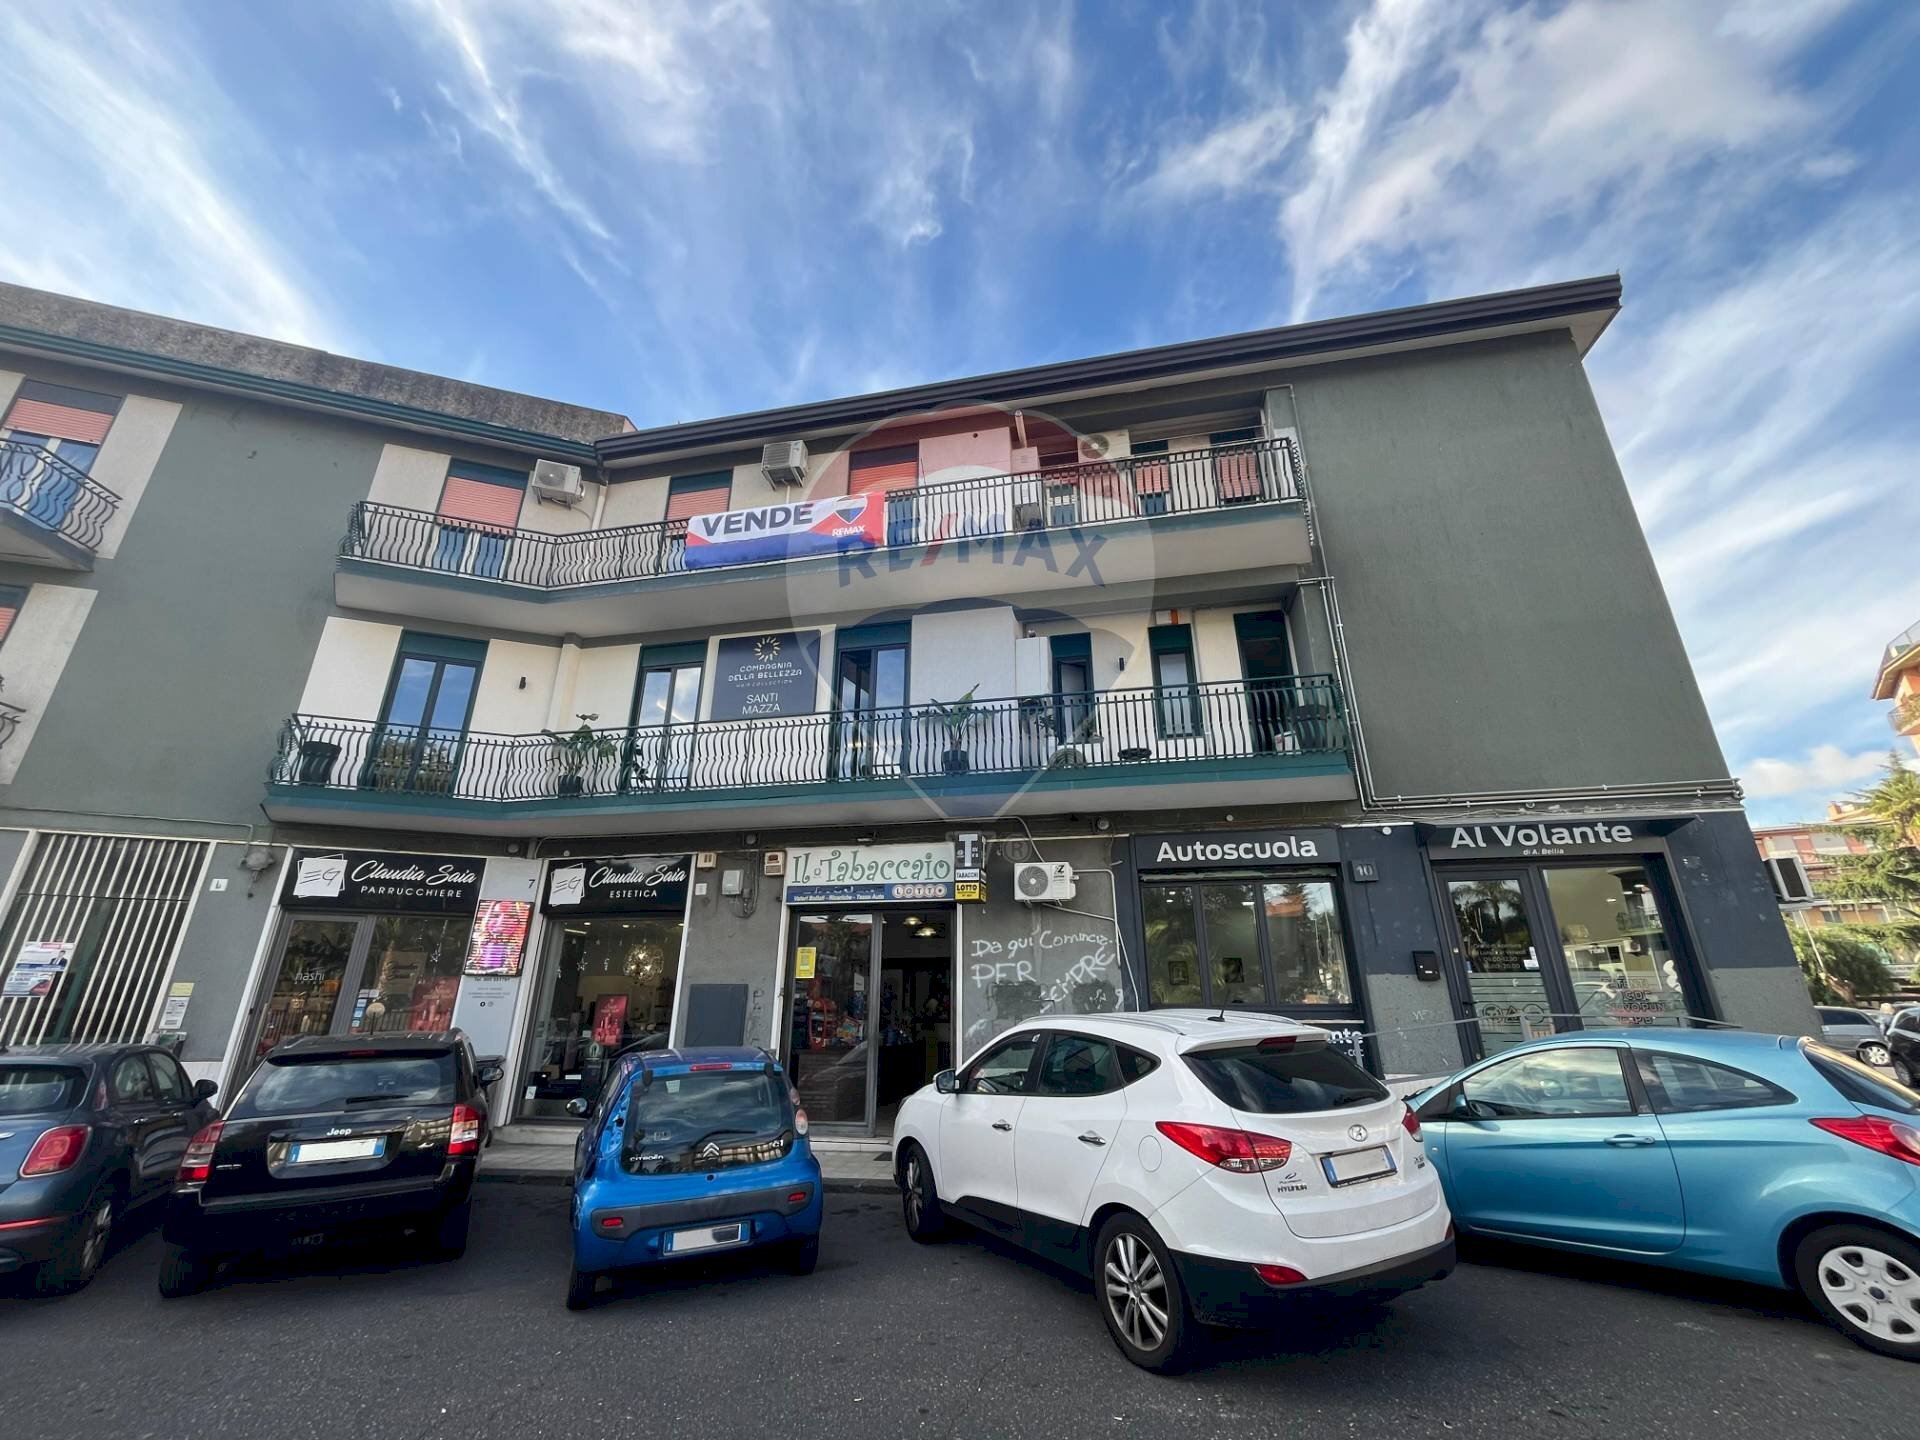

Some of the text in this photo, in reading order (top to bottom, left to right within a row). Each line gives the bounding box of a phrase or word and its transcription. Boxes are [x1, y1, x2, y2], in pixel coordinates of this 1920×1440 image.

[702, 503, 814, 536] VENDE
[740, 661, 792, 672] COMPAGNIA
[728, 669, 802, 682] DELLA BELLEZZA
[746, 692, 779, 704] SANTI
[742, 703, 781, 715] MAZZA
[1451, 822, 1633, 849] Al Volante
[1156, 836, 1319, 862] Autoscuola
[351, 859, 477, 886] Claudia Saia
[792, 849, 950, 884] Il Tabaccaio
[589, 864, 687, 888] Claudia Saia
[361, 885, 463, 898] PARRUCCHIERE
[528, 879, 536, 889] 7
[609, 889, 658, 899] ESTETICA
[971, 939, 1003, 957] Da
[971, 960, 1036, 988] PER
[327, 1127, 352, 1136] Jeep
